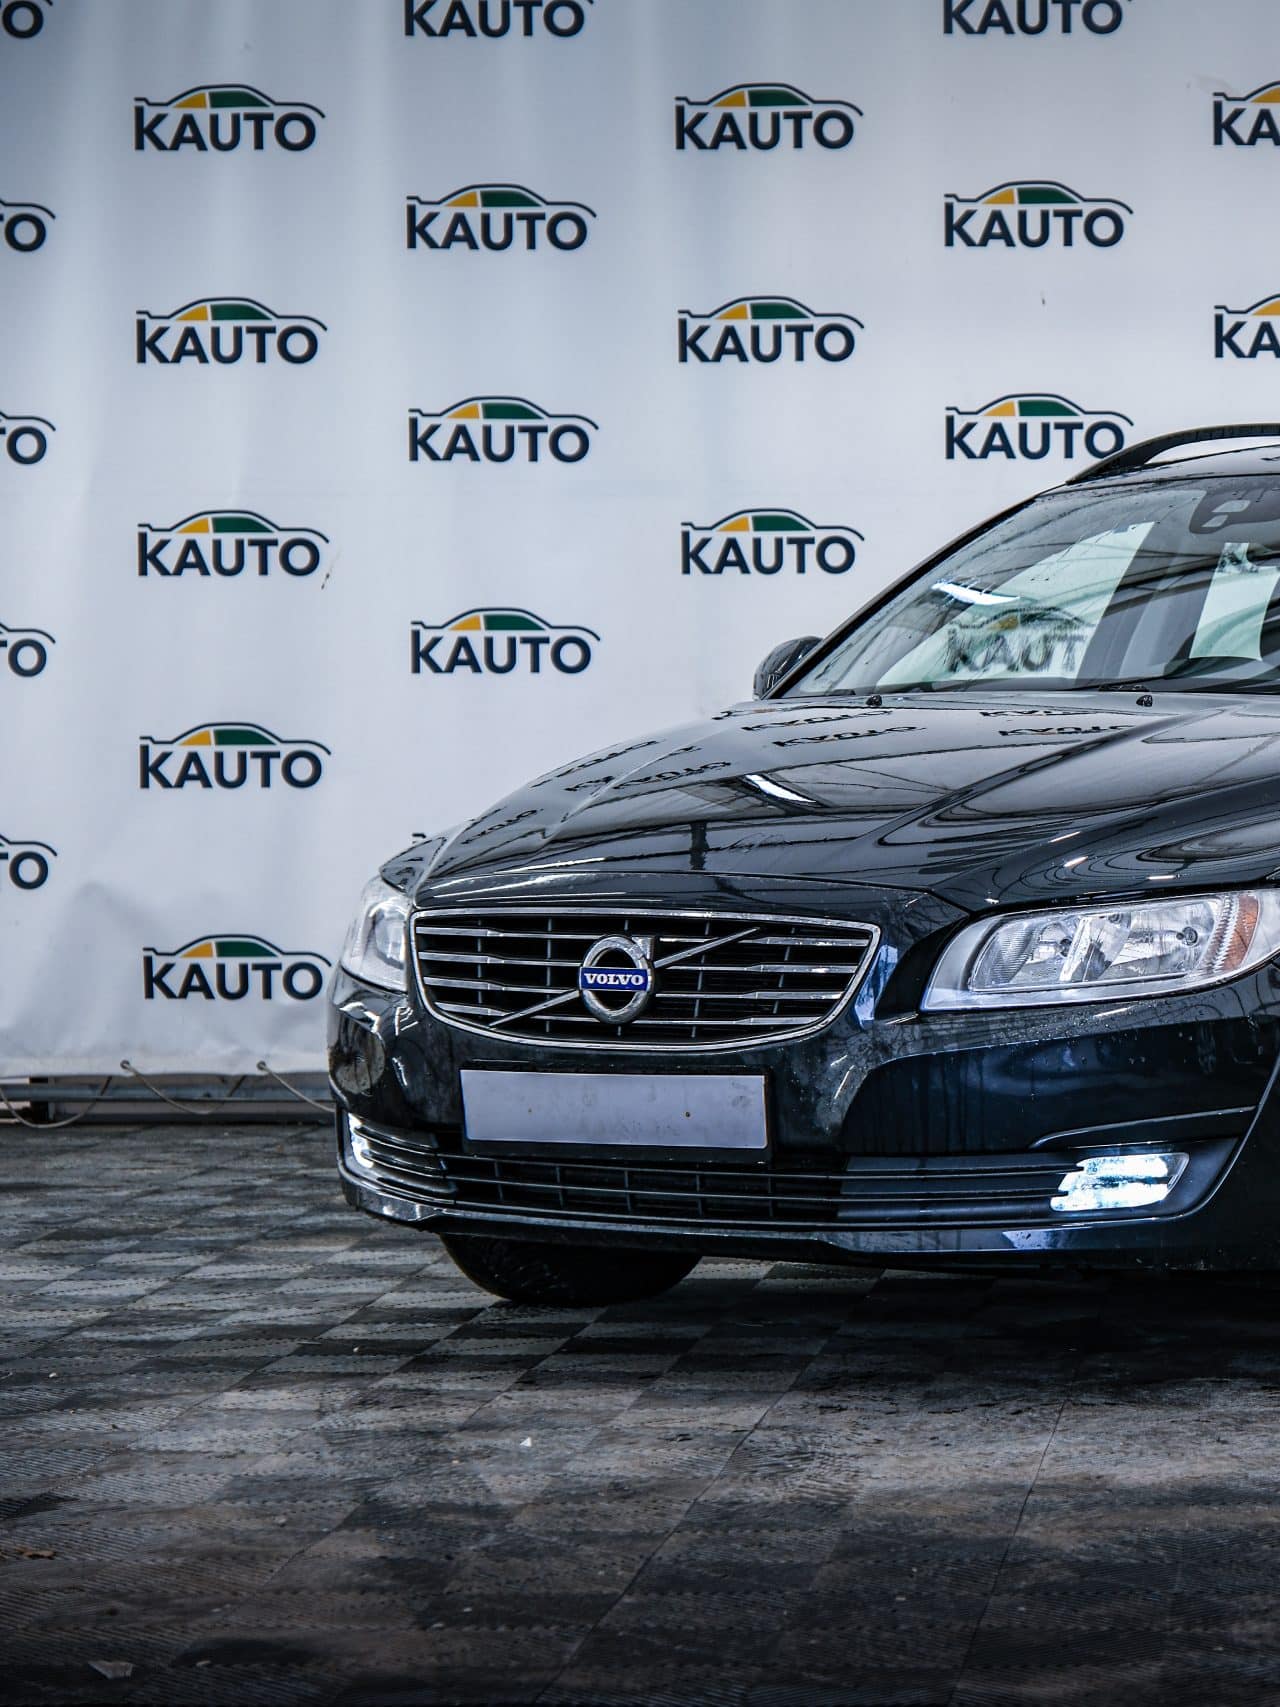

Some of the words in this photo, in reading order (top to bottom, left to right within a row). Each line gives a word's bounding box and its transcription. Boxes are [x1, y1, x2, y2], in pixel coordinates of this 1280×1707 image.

[405, 0, 584, 38] KAUTO
[944, 0, 1122, 35] KAUTO
[134, 106, 315, 151] KAUTO
[675, 105, 853, 150] KAUTO
[407, 206, 587, 251] KAUTO
[944, 203, 1123, 247] KAUTO
[136, 320, 318, 364] KAUTO
[678, 318, 854, 363] KAUTO
[409, 419, 589, 462] KAUTO
[946, 416, 1124, 459] KAUTO
[138, 532, 320, 576] KAUTO
[682, 531, 855, 575] KAUTO
[412, 630, 591, 674] KAUTO
[140, 745, 321, 789] KAUTO
[143, 956, 322, 1000] KAUTO
[583, 972, 644, 986] VOLVO
